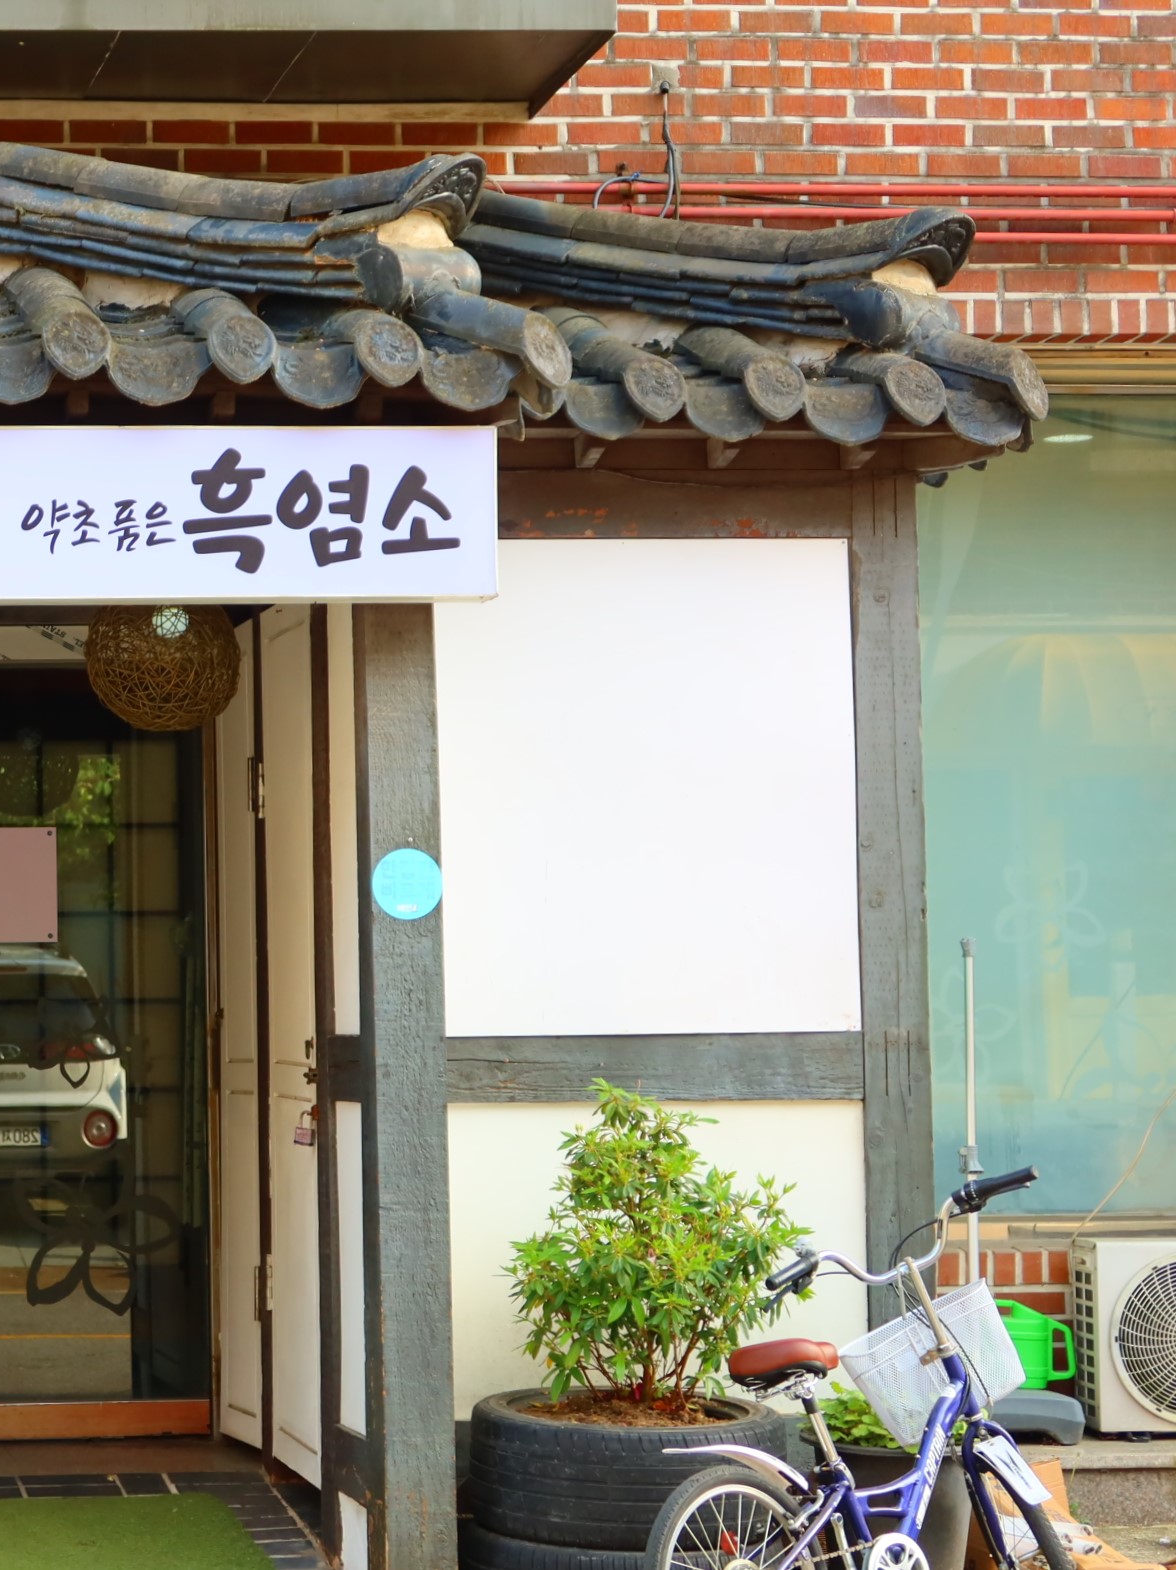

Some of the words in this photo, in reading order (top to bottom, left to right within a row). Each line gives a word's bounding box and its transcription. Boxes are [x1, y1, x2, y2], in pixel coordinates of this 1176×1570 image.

[21, 498, 101, 554] 약초
[108, 498, 176, 552] 품은
[183, 447, 461, 574] 흑염소
